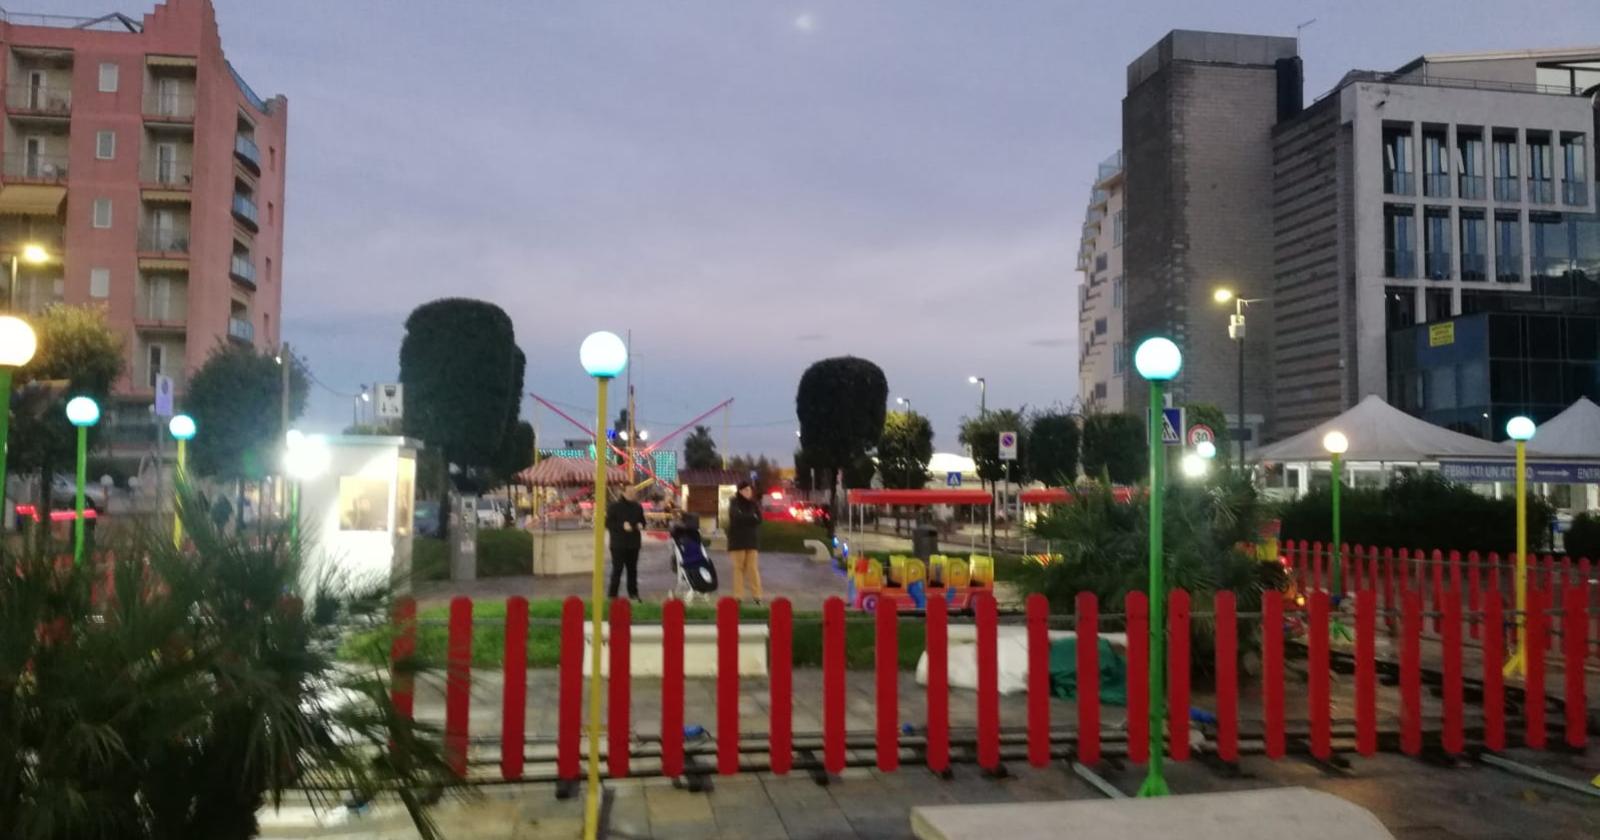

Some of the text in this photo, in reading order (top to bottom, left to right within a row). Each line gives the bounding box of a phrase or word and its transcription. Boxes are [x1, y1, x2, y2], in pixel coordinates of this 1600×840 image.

[1444, 464, 1483, 477] FERMATI
[1485, 465, 1498, 478] UN
[1500, 466, 1534, 479] ATTO
